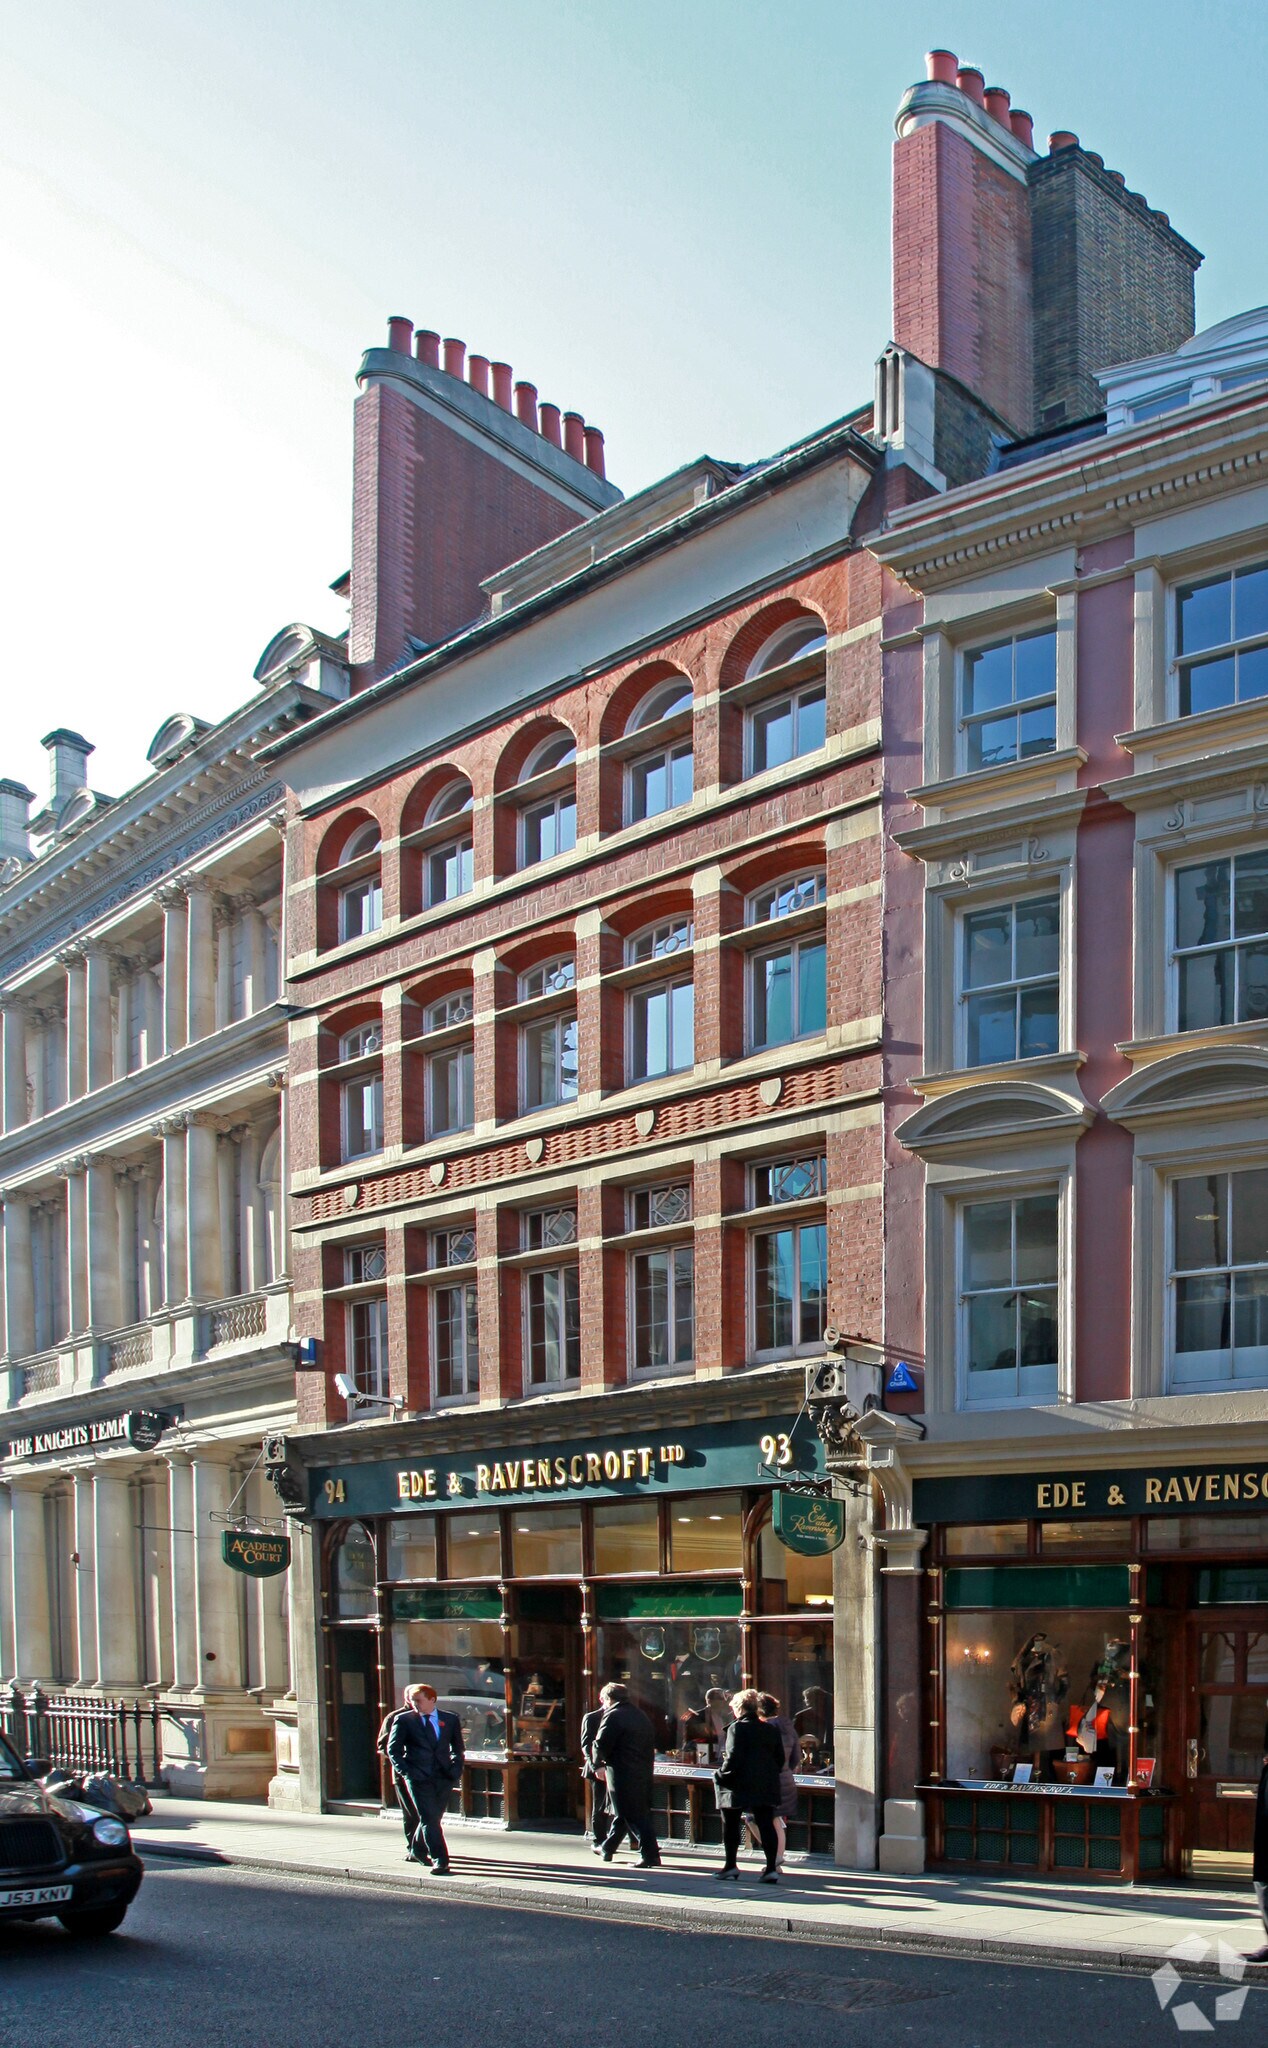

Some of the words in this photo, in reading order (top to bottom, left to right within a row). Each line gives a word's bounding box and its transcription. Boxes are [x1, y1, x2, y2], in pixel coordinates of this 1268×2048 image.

[9, 1439, 33, 1457] THE
[34, 1425, 88, 1454] KNIGHTS
[760, 1433, 793, 1465] 93
[398, 1469, 437, 1498] EDE
[448, 1472, 463, 1494] &
[476, 1447, 653, 1491] RAVENSCROFT
[660, 1445, 685, 1463] LTD
[324, 1478, 345, 1504] 94
[1037, 1481, 1087, 1509] EDE
[1107, 1484, 1127, 1506] &
[807, 1503, 827, 1523] Ede
[815, 1519, 834, 1527] and
[790, 1514, 838, 1537] Ravenscroft
[231, 1539, 284, 1554] ACADEMY
[243, 1549, 282, 1564] COURT
[1, 1892, 34, 1904] J53
[39, 1887, 69, 1901] KNV
